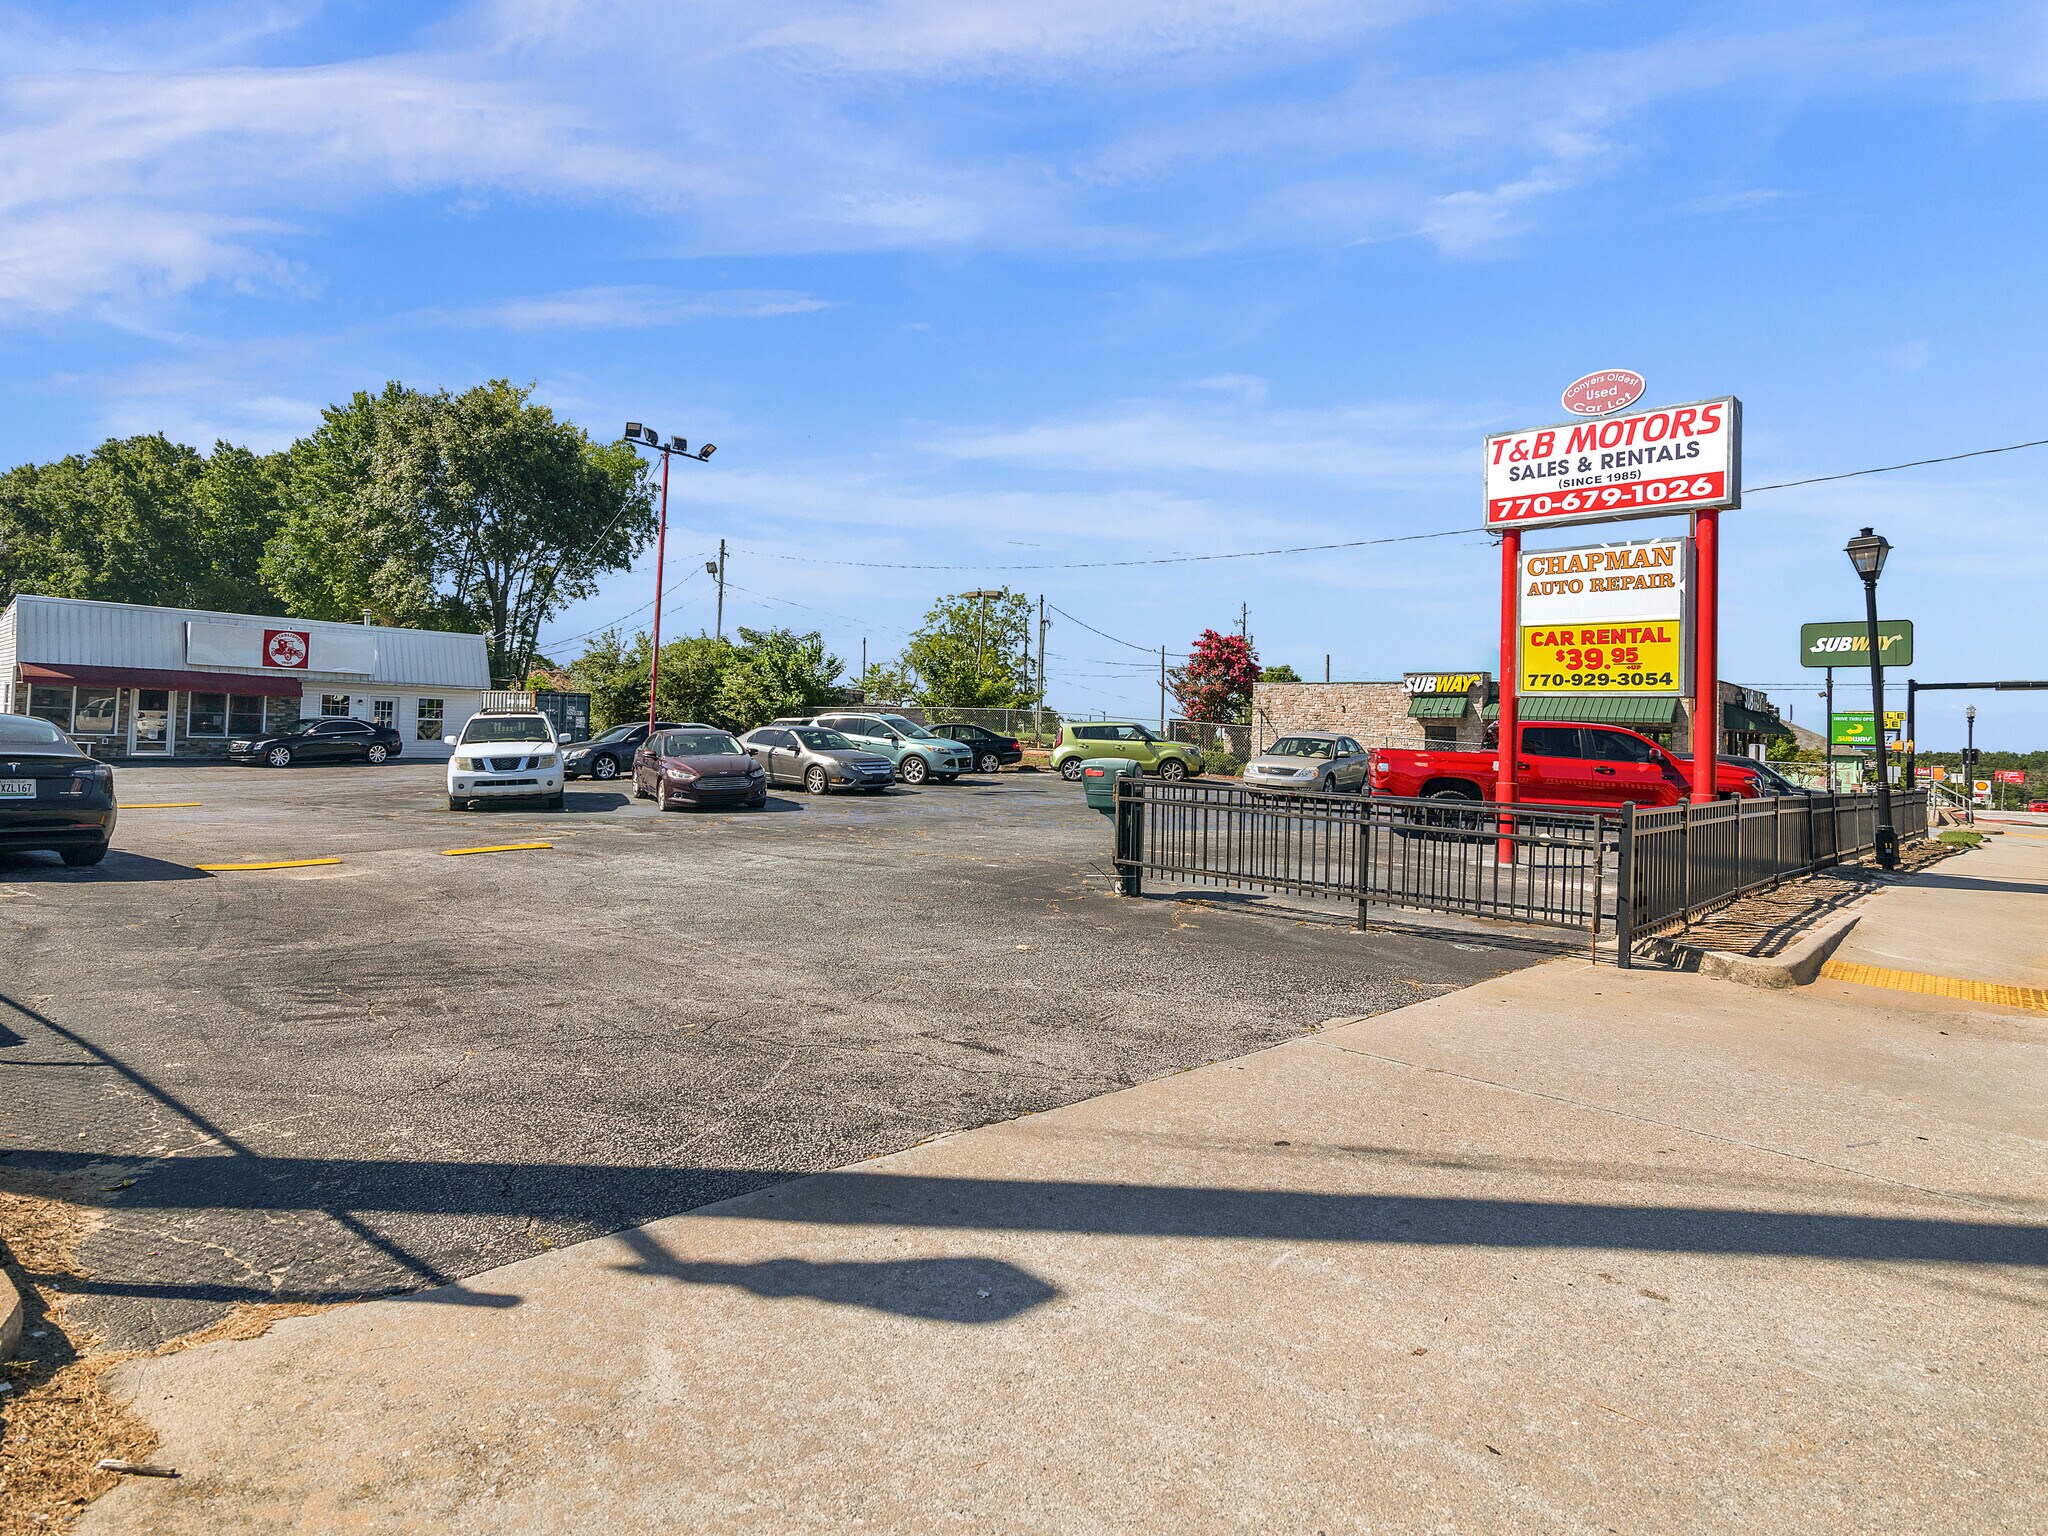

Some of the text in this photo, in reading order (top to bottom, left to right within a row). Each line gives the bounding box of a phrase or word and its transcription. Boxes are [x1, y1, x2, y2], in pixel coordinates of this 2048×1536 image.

[1567, 373, 1639, 398] Conyers Oldest
[1586, 385, 1618, 400] Used
[1573, 392, 1632, 412] Car Lot
[1492, 404, 1723, 465] T&B MOTORS
[1509, 441, 1700, 482] SALES & RENTALS
[1558, 469, 1642, 490] (SINCE 1985)
[1497, 476, 1713, 519] 770-679-1026
[1527, 546, 1676, 577] CHAPMAN
[1527, 573, 1675, 596] AUTO REPAIR
[1531, 627, 1671, 647] CAR RENTAL
[1809, 634, 1903, 653] SUBWY
[1401, 675, 1481, 693] SUBWAY
[1528, 672, 1673, 687] 770-929-3054
